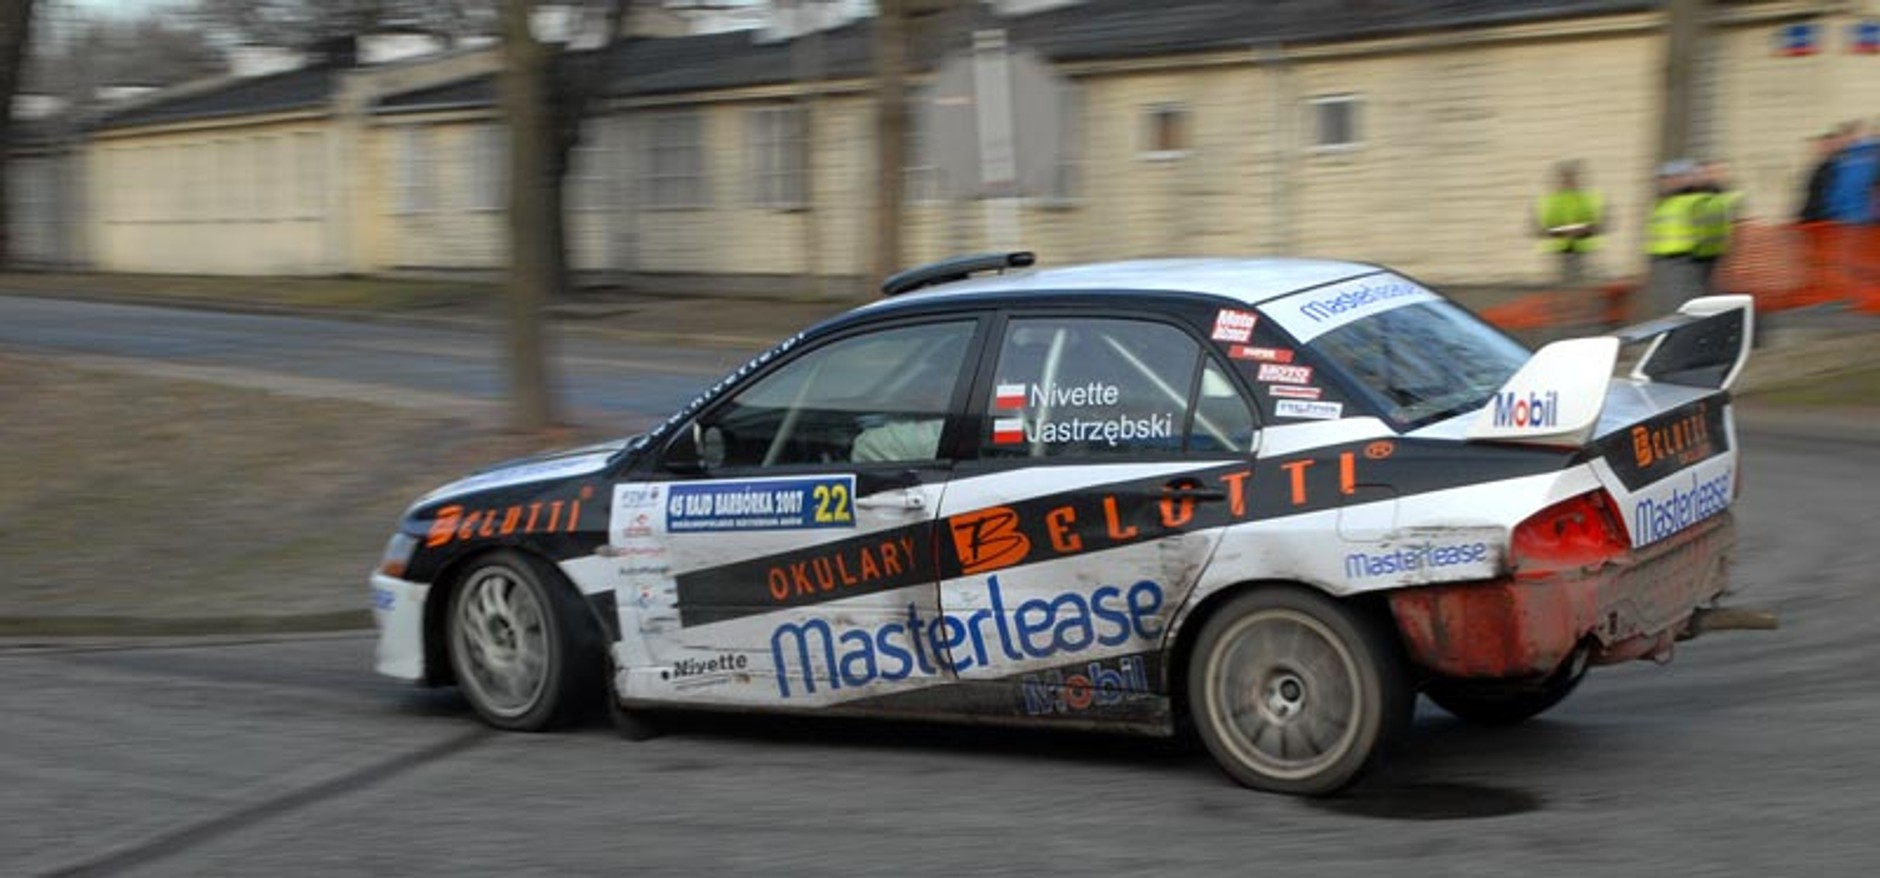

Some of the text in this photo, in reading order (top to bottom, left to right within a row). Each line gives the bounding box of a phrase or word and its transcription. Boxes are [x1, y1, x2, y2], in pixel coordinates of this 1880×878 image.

[1029, 382, 1120, 408] Nivette
[1491, 390, 1559, 428] Mobil
[1026, 413, 1173, 447] Jastrzębski
[669, 494, 683, 517] 45
[686, 493, 713, 516] RAJD
[776, 490, 804, 513] 2007
[812, 484, 852, 523] 22
[767, 536, 917, 600] OKULARY
[1345, 541, 1487, 579] Masterlease
[771, 574, 1165, 698] Masterlease
[673, 654, 748, 679] Nivette
[1023, 655, 1149, 715] Mobil
